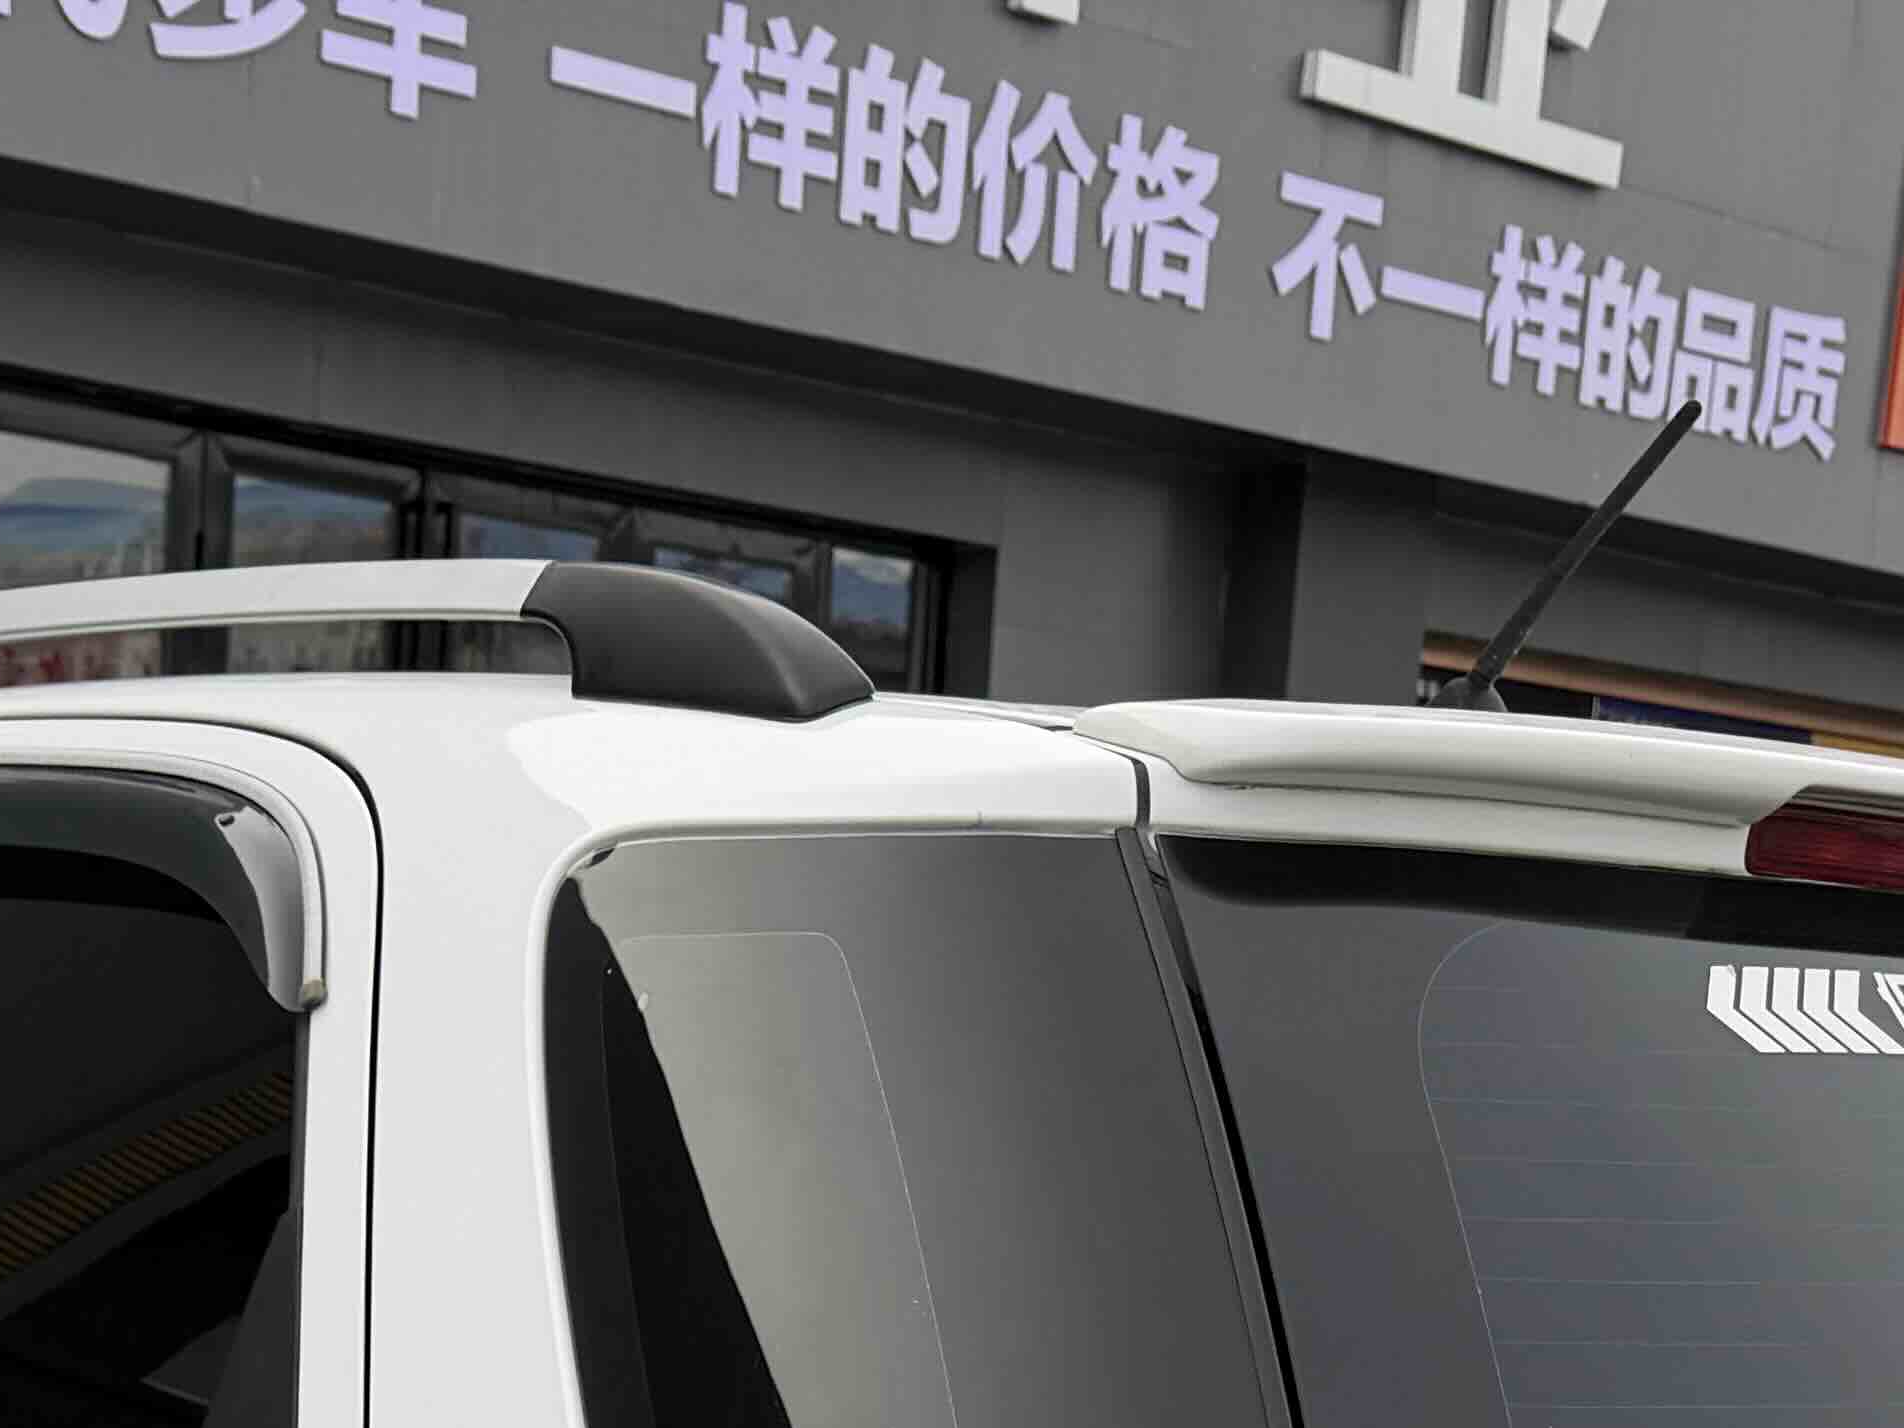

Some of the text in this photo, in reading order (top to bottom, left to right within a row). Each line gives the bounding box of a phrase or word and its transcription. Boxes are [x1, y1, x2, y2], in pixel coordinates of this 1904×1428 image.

[550, 2, 1221, 311] 一样的价格
[1271, 171, 1848, 460] 不一样的品质
